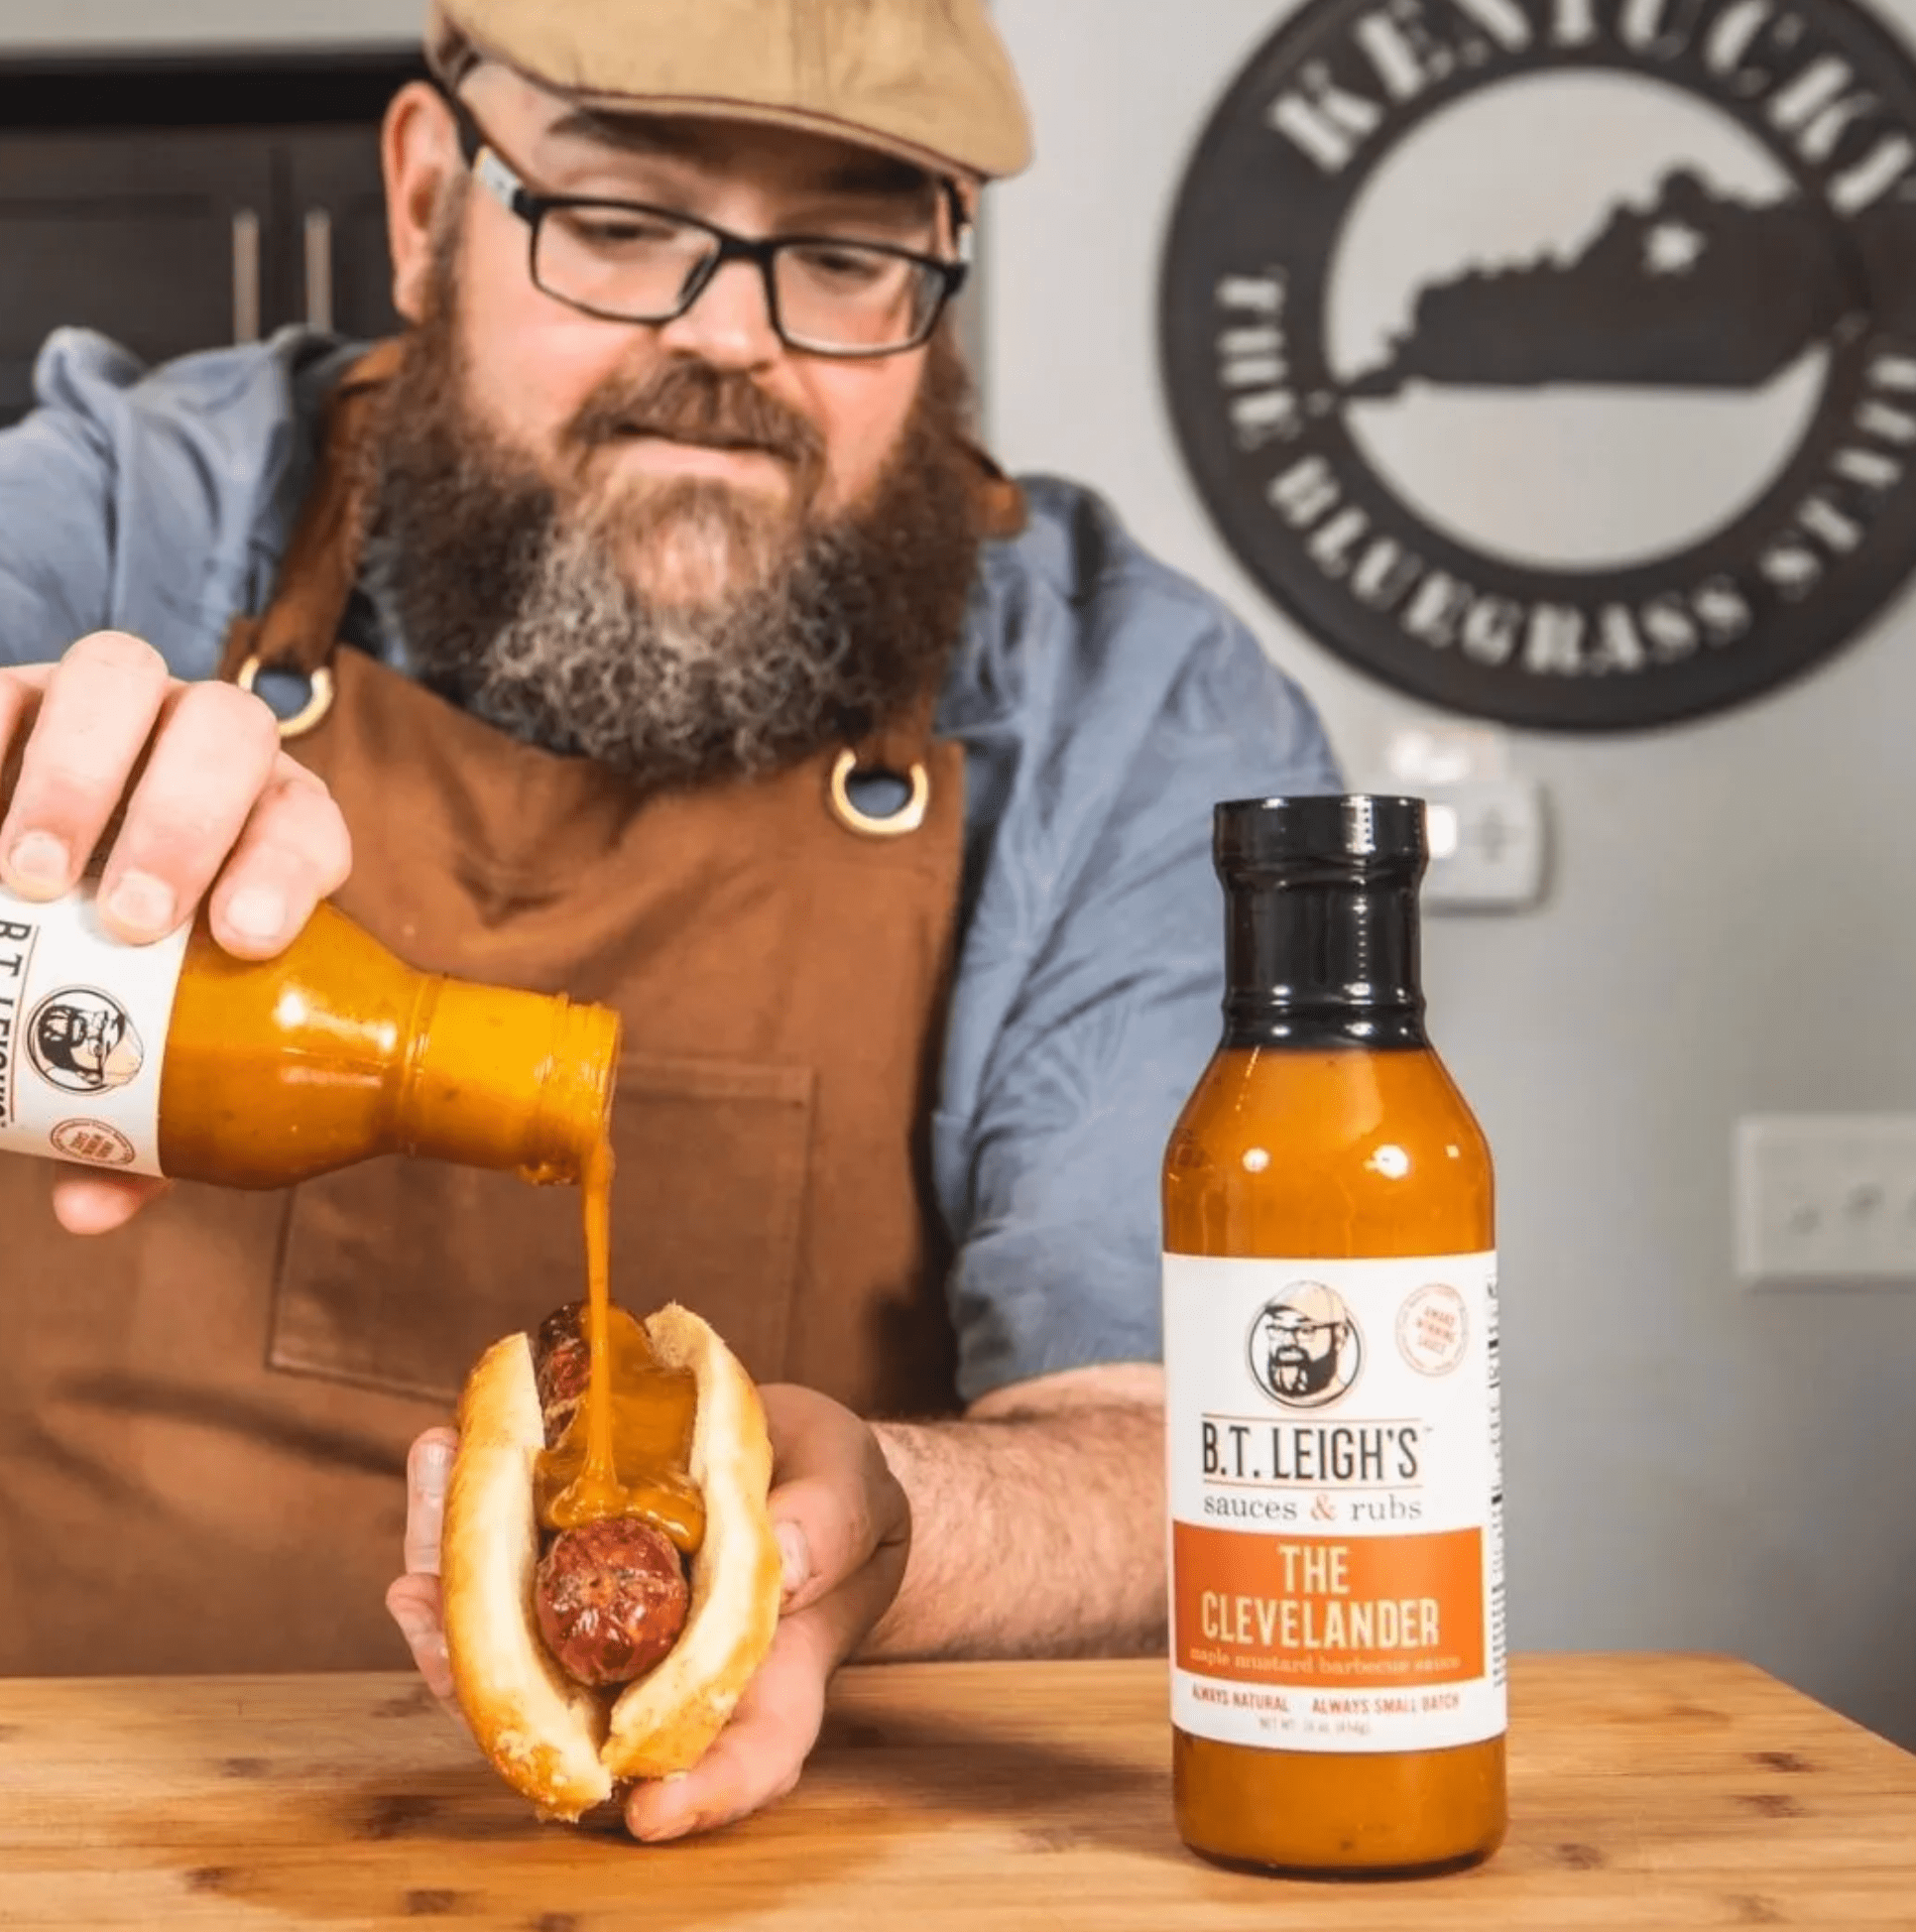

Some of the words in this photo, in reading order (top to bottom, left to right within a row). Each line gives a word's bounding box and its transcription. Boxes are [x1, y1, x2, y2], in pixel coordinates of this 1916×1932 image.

[1216, 266, 1295, 449] THE
[1269, 454, 1753, 674] BLUEGRASS
[0, 918, 31, 978] BT
[1202, 1421, 1260, 1479] B.T.
[1272, 1426, 1419, 1481] LEIGH'S
[1203, 1495, 1298, 1520] sauces
[1309, 1494, 1337, 1522] &
[1352, 1495, 1422, 1521] rubs
[1278, 1544, 1351, 1595] THE
[1201, 1591, 1440, 1650] CLEVELANDER
[1189, 1646, 1230, 1668] maple
[1234, 1653, 1314, 1675] mustard
[1318, 1654, 1410, 1675] barbecue
[1414, 1655, 1462, 1673] sauce
[1192, 1681, 1230, 1707] ALWAYS
[1232, 1691, 1289, 1714] NATURAL
[1312, 1696, 1369, 1716] ALWAYS
[1374, 1695, 1416, 1716] SMALL
[1421, 1691, 1460, 1713] BATCH
